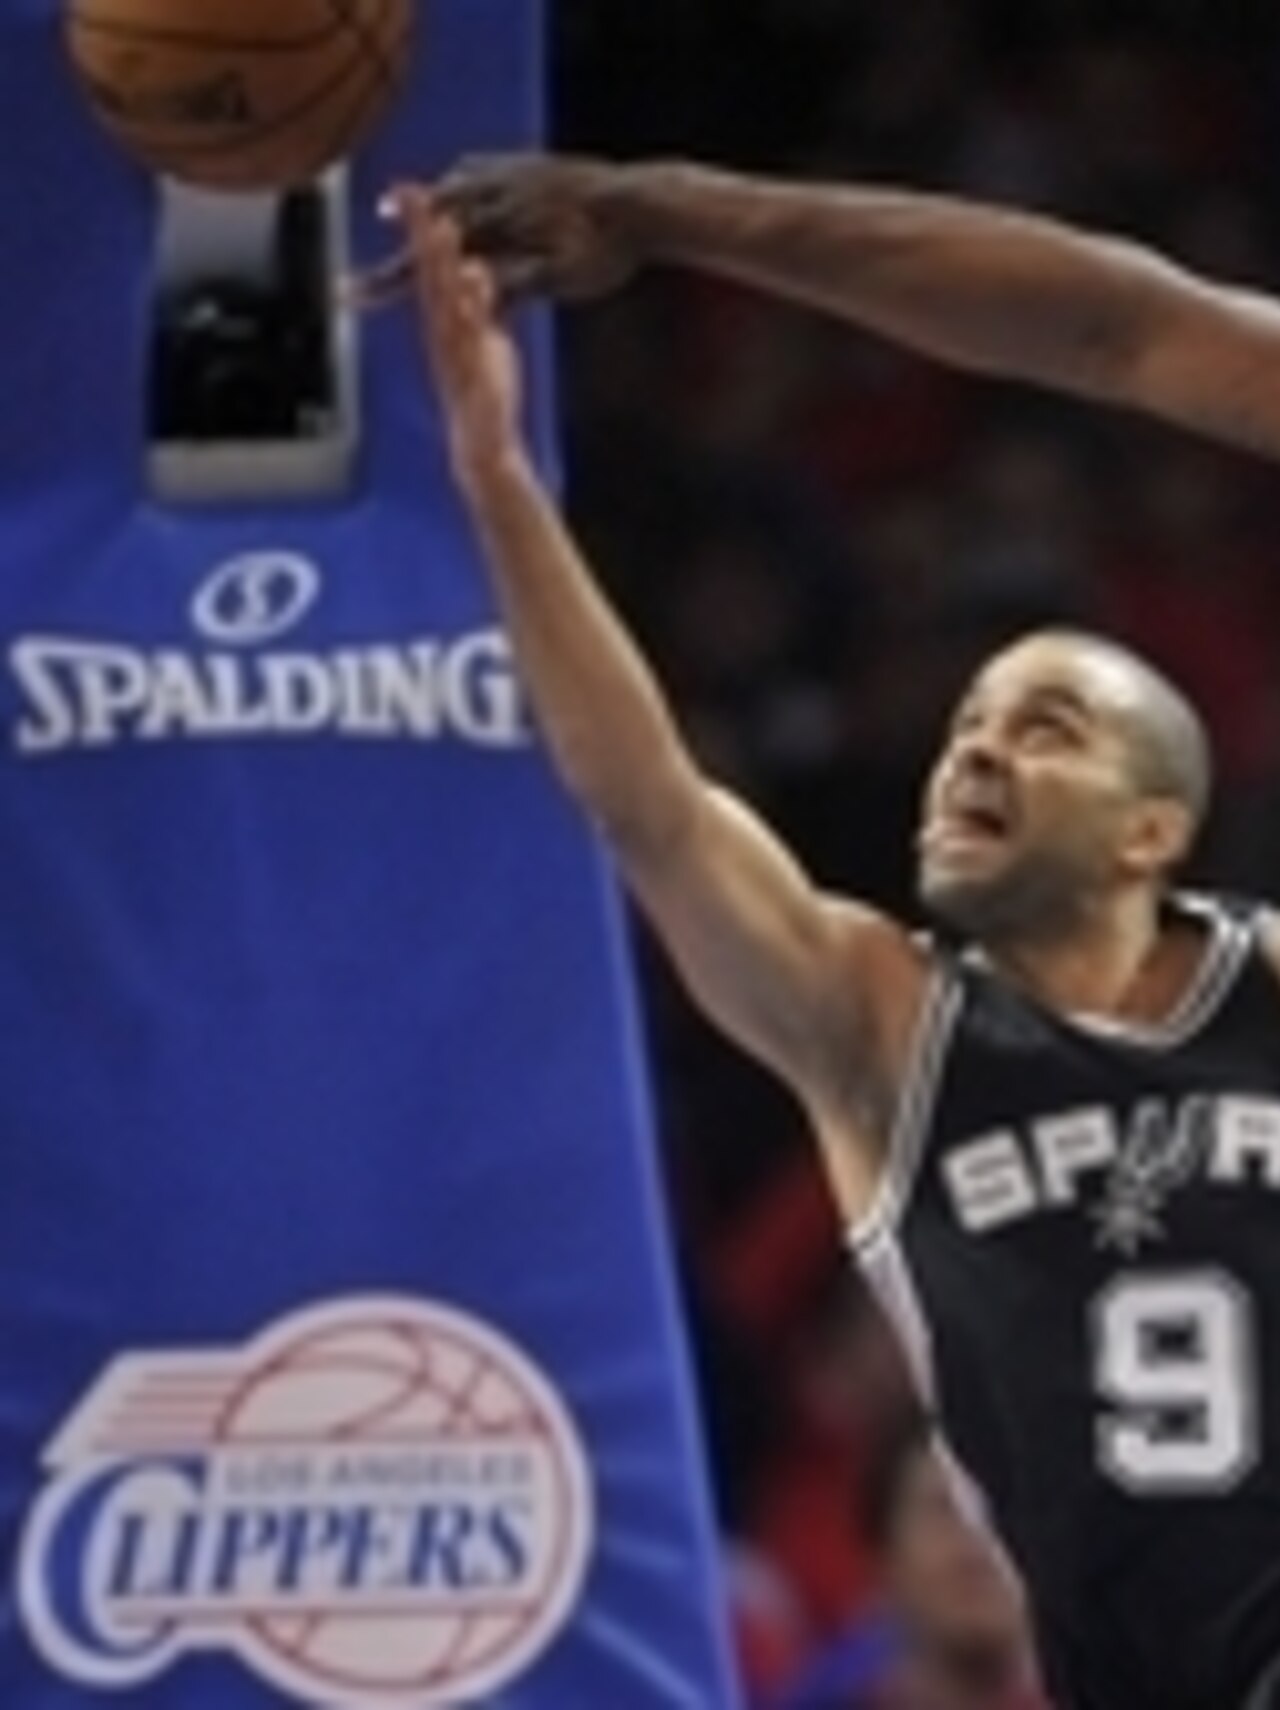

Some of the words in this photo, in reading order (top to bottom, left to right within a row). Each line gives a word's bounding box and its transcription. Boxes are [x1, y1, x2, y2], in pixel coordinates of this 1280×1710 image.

[10, 628, 531, 753] SPALDING
[1094, 1270, 1258, 1496] 9
[224, 1454, 316, 1492] LOS
[326, 1451, 533, 1487] ANGELES
[40, 1455, 532, 1660] CLIPPERS
